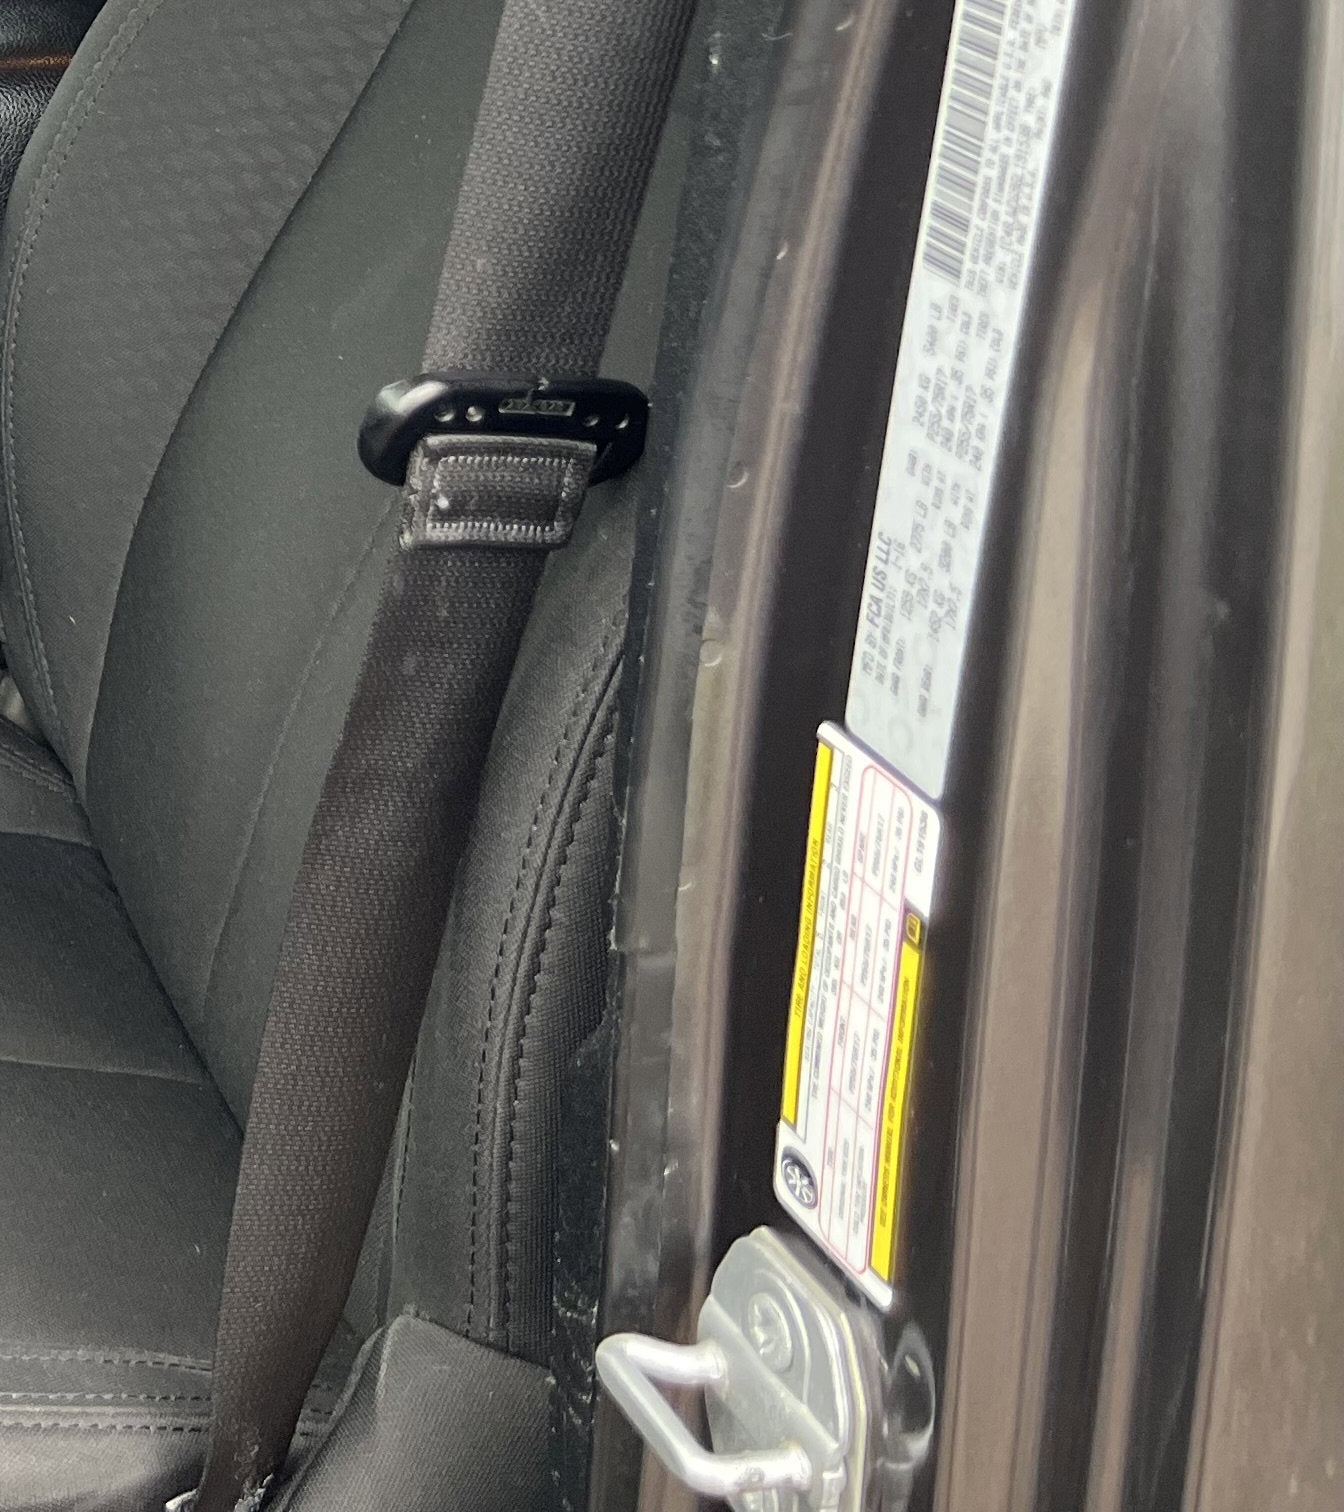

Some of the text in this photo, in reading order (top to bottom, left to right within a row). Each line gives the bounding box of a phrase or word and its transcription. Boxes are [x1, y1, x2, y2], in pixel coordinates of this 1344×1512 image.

[875, 531, 892, 565] LLC
[871, 566, 887, 592] US
[866, 594, 883, 628] FCA
[794, 839, 818, 1017] TIRE AND LOADING INFORMATION
